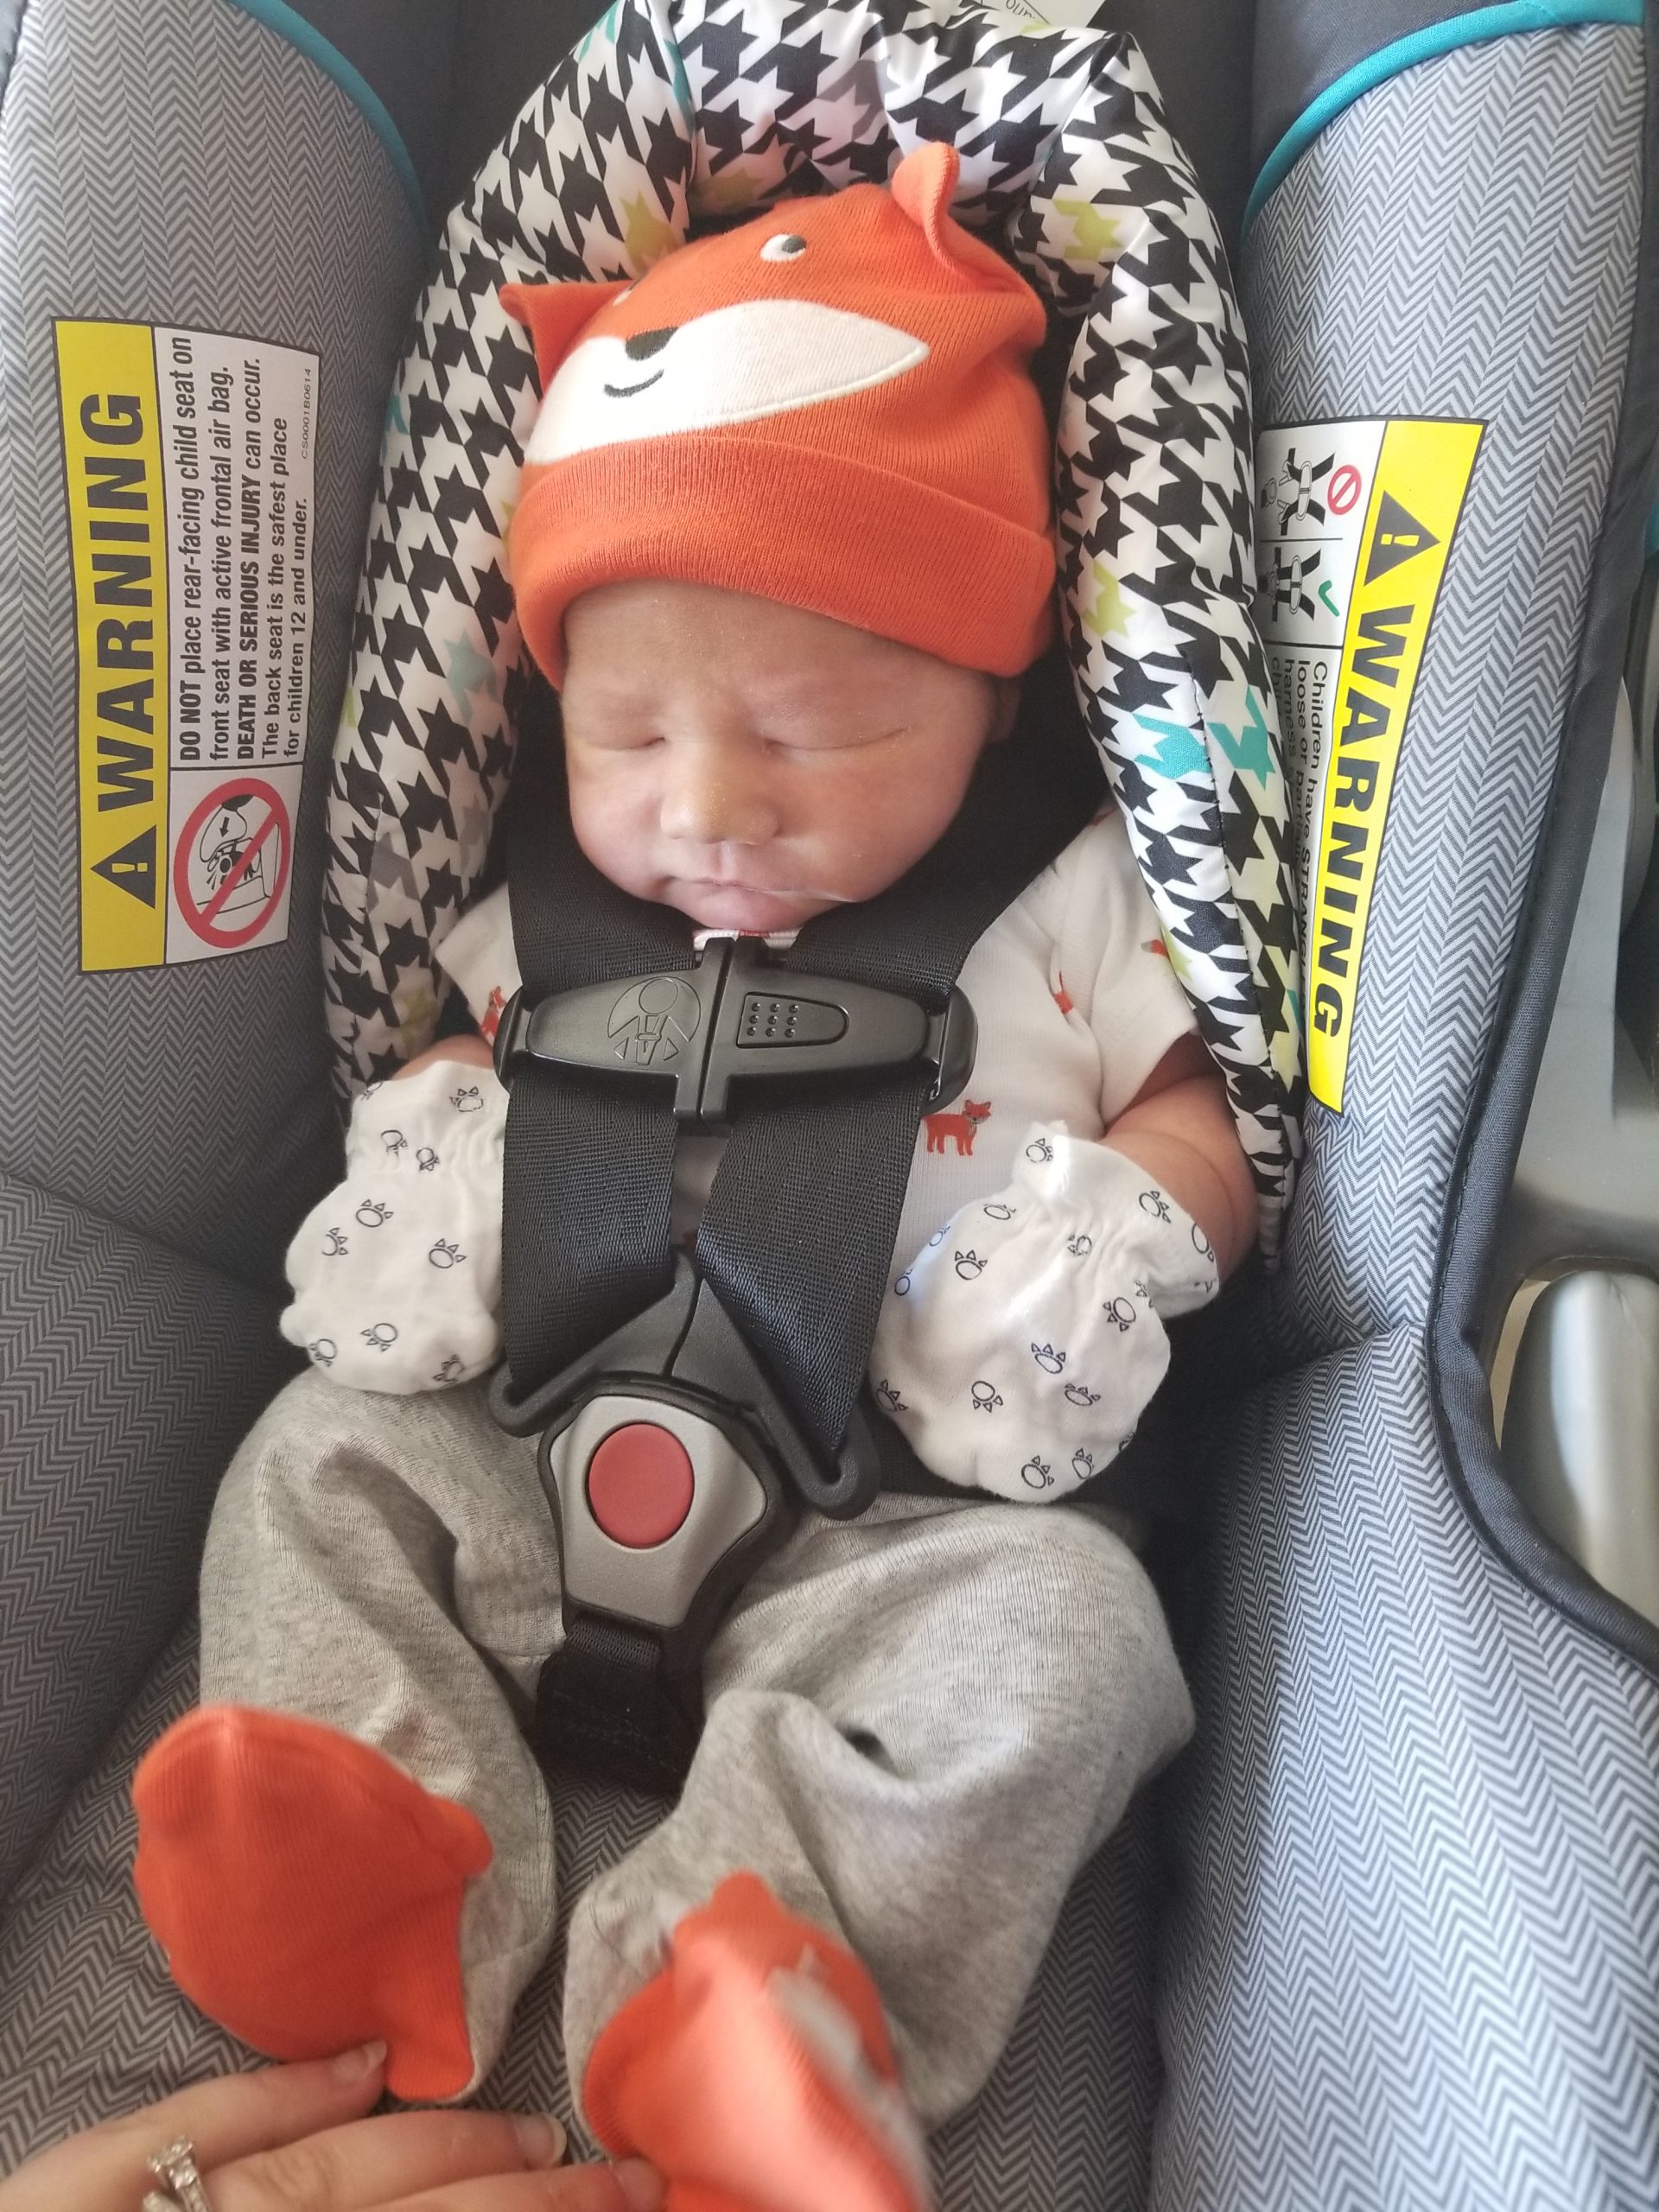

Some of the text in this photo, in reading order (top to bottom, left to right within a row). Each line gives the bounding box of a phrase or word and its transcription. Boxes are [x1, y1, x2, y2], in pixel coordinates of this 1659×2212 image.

[302, 369, 311, 459] CS0001B0614
[80, 394, 154, 812] WARNING
[169, 338, 206, 760] DO NOT place rear-facing child seat on
[207, 367, 233, 760] front seat with active frontal air bag.
[238, 359, 261, 759] DEATH OR SERIOUS INJURY can occur.
[262, 417, 289, 759] The back seat is the safest place
[284, 499, 307, 757] for children 12 and under.
[1285, 659, 1296, 756] harness
[1297, 660, 1310, 728] loose
[1300, 738, 1307, 765] or
[1304, 778, 1318, 839] have
[1312, 662, 1327, 768] Children
[1314, 604, 1414, 1037] WARNING
